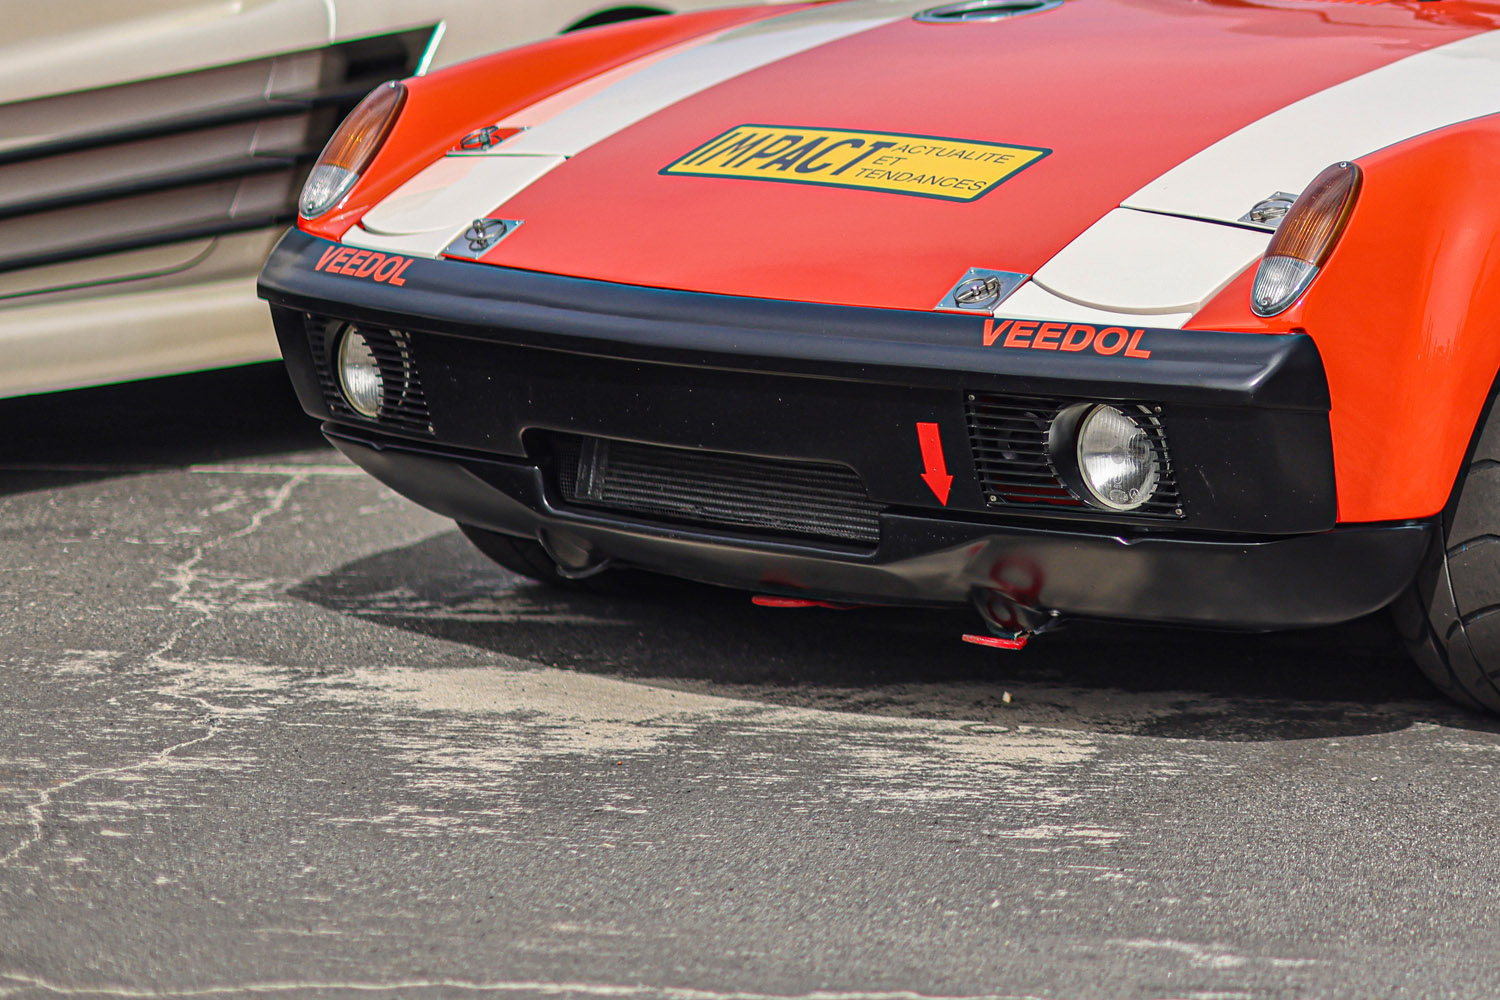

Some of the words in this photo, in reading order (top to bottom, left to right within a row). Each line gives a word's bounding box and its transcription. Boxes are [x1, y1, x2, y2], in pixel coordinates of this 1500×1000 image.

[683, 130, 897, 176] IMPACT
[872, 155, 908, 167] ET
[890, 143, 1016, 165] ACTUALITE
[853, 166, 988, 192] TENDANCES
[314, 245, 415, 287] VEEDOL
[982, 318, 1152, 360] VEEDOL
